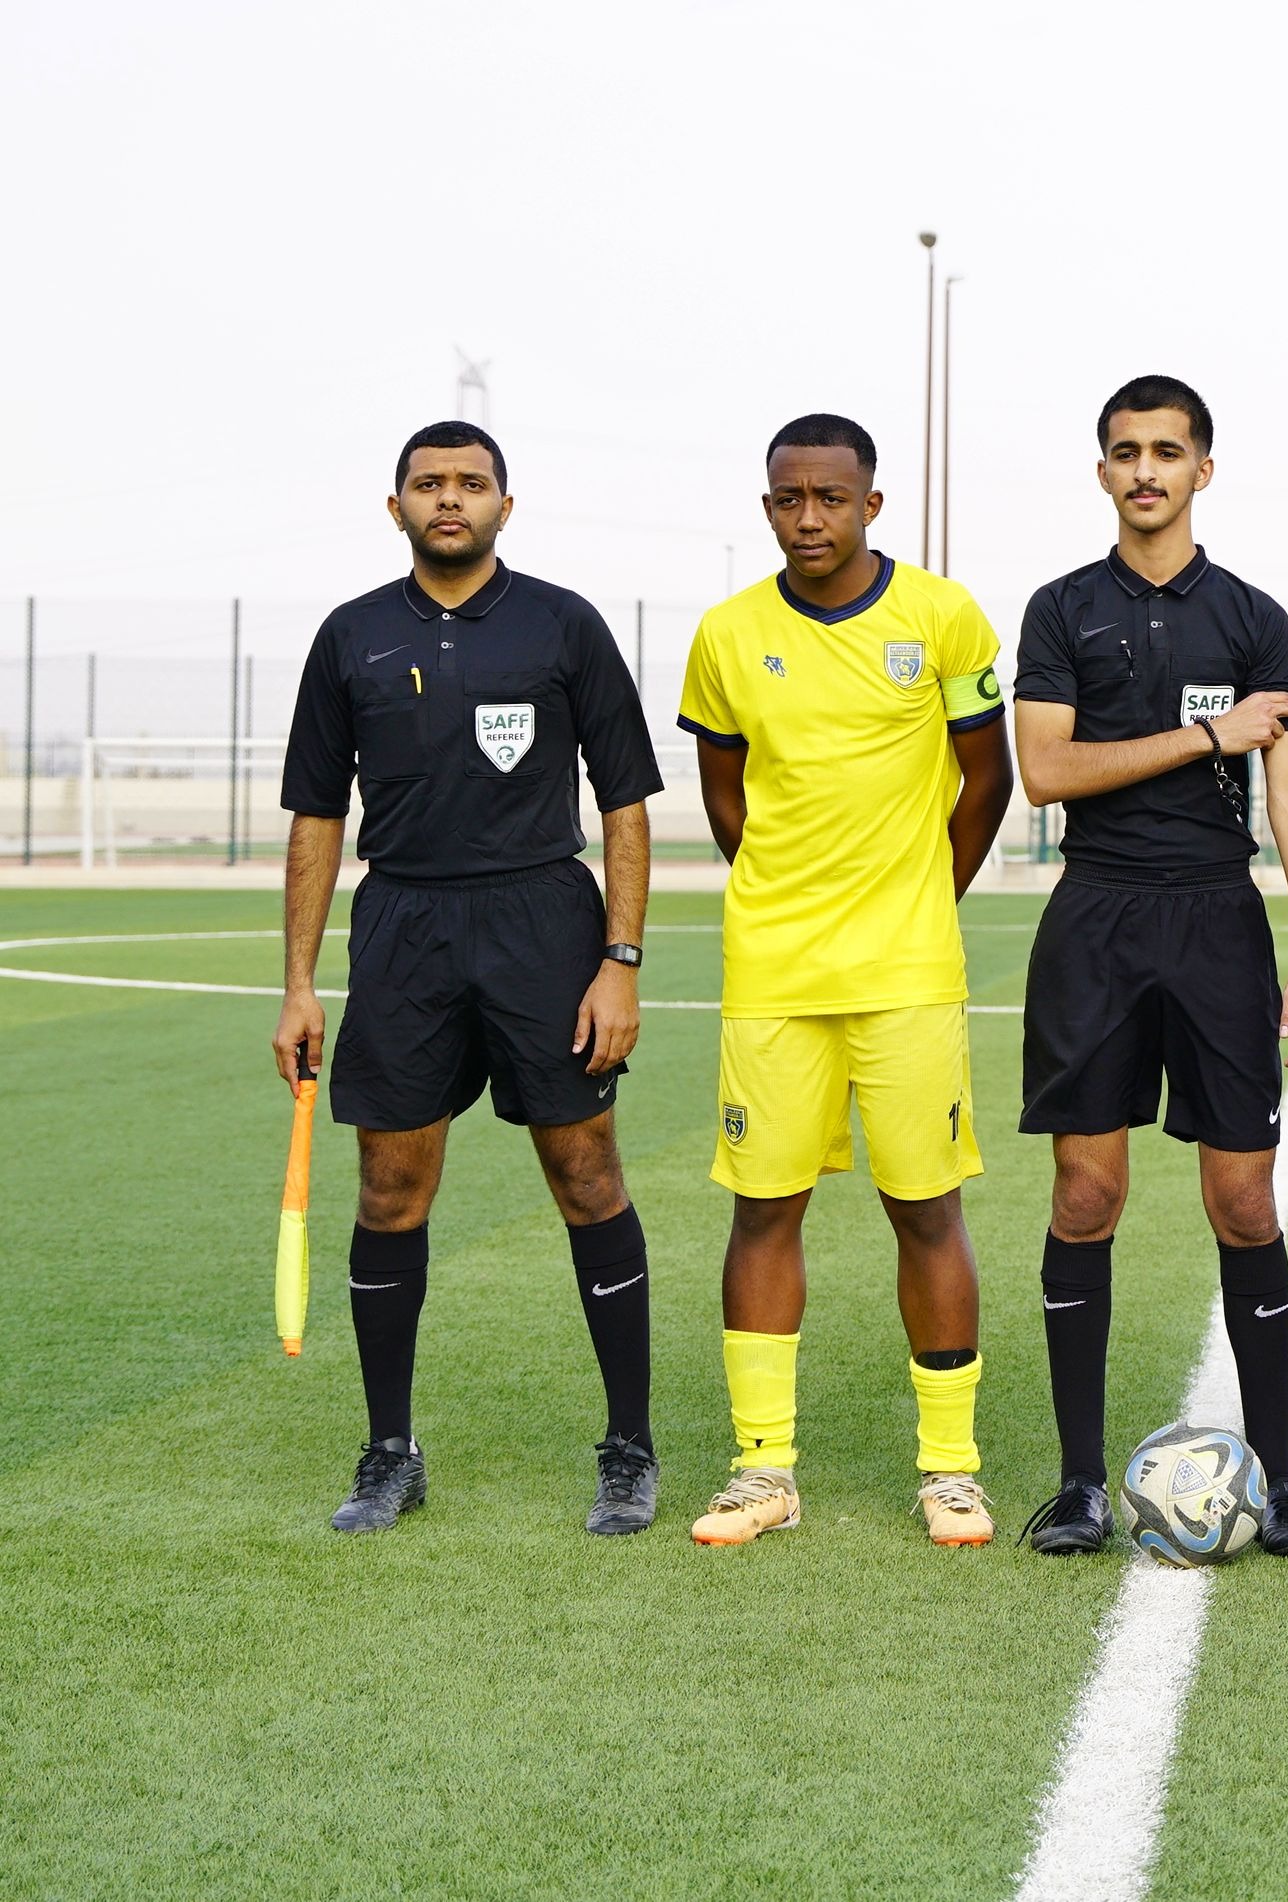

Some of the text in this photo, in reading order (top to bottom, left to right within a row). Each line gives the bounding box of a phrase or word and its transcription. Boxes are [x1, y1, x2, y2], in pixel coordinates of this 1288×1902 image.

[1187, 695, 1230, 710] SAFF
[482, 713, 529, 730] SAFF
[486, 732, 525, 742] REFEREE
